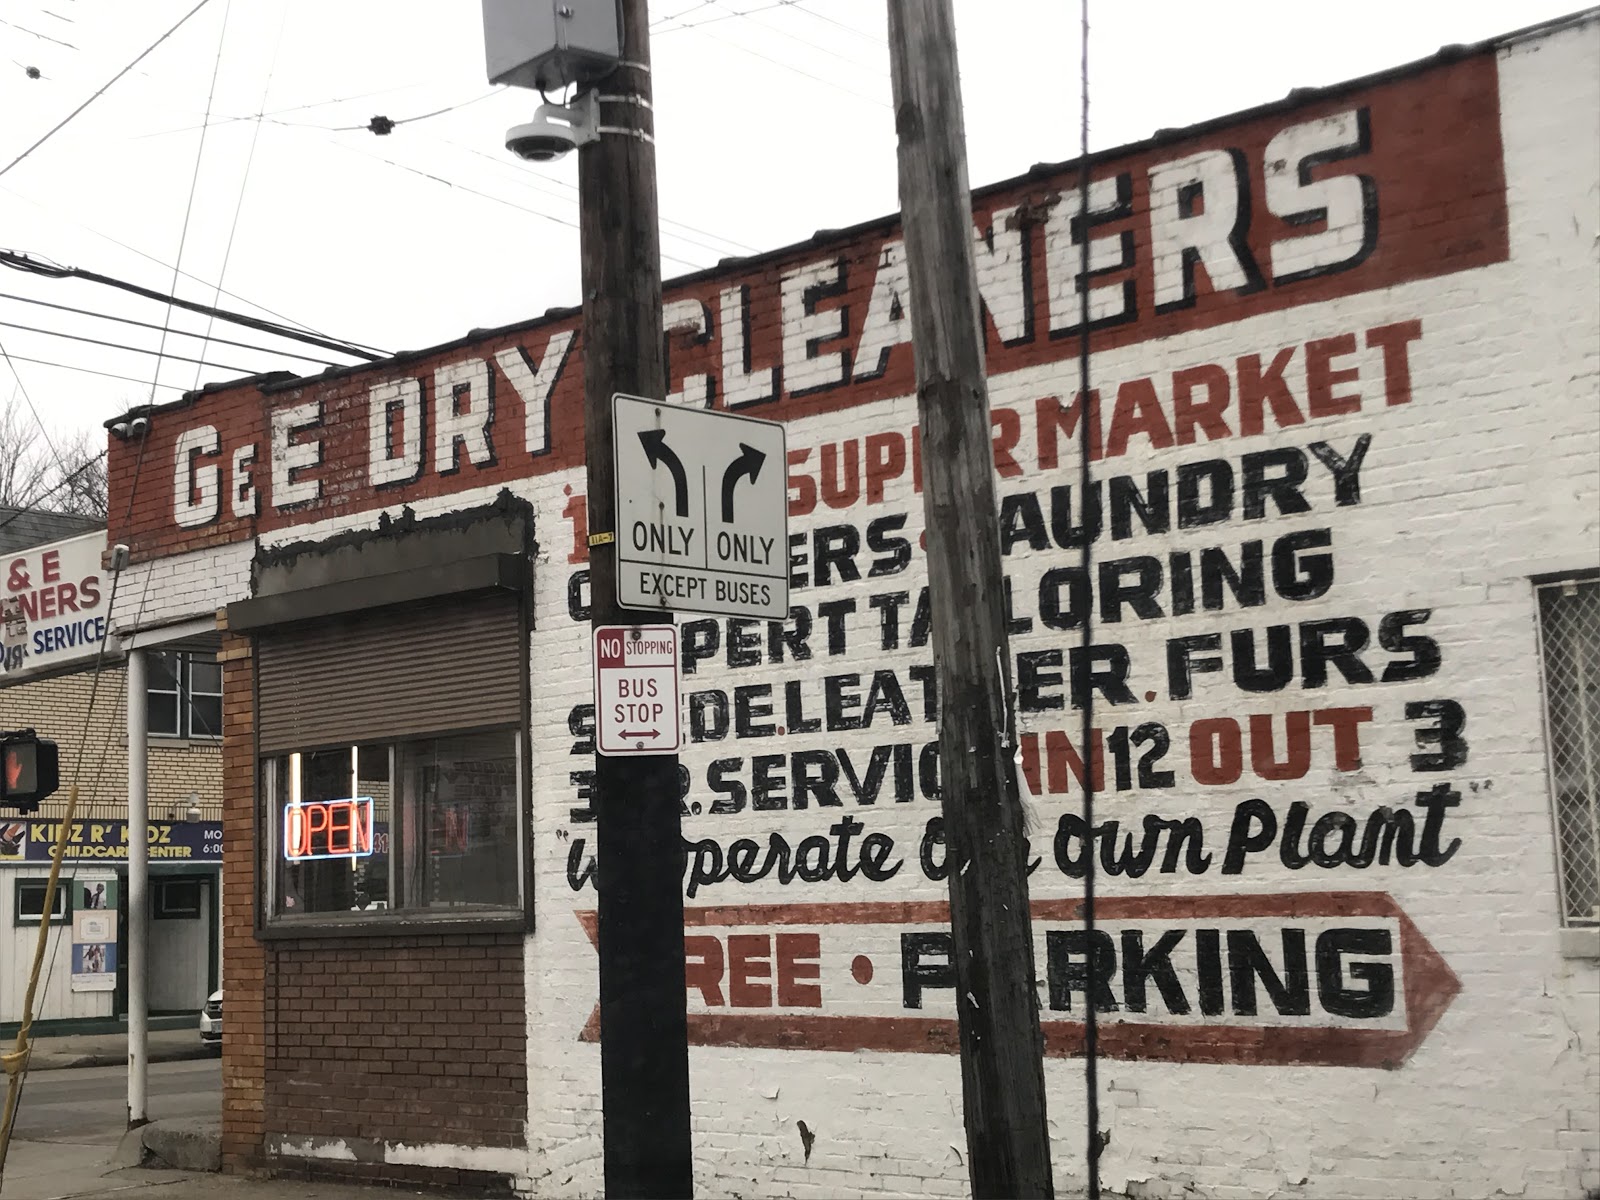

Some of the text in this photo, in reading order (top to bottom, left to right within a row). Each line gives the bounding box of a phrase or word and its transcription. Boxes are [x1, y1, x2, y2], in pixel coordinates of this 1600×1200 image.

[369, 329, 578, 490] DRY
[1000, 433, 1372, 556] AUNDRY
[632, 521, 694, 556] ONLY
[717, 531, 774, 565] ONLY
[42, 549, 61, 583] E
[640, 572, 771, 606] EXCEPT BUSES
[681, 527, 1334, 675] PERT TLORING
[33, 616, 105, 655] SERVICE
[600, 638, 673, 659] NO STOPPING
[1166, 608, 1443, 701] FURS
[618, 678, 658, 698] BUS
[614, 703, 664, 723] STOP
[1020, 728, 1105, 795] IN
[1107, 721, 1176, 792] 12
[1189, 706, 1374, 786] OUT
[1404, 699, 1469, 773] 3
[286, 801, 371, 857] OPEN
[149, 846, 192, 858] ENTER
[681, 815, 904, 899] perate
[1053, 813, 1213, 879] own
[684, 927, 1394, 1019] REE PRKING
